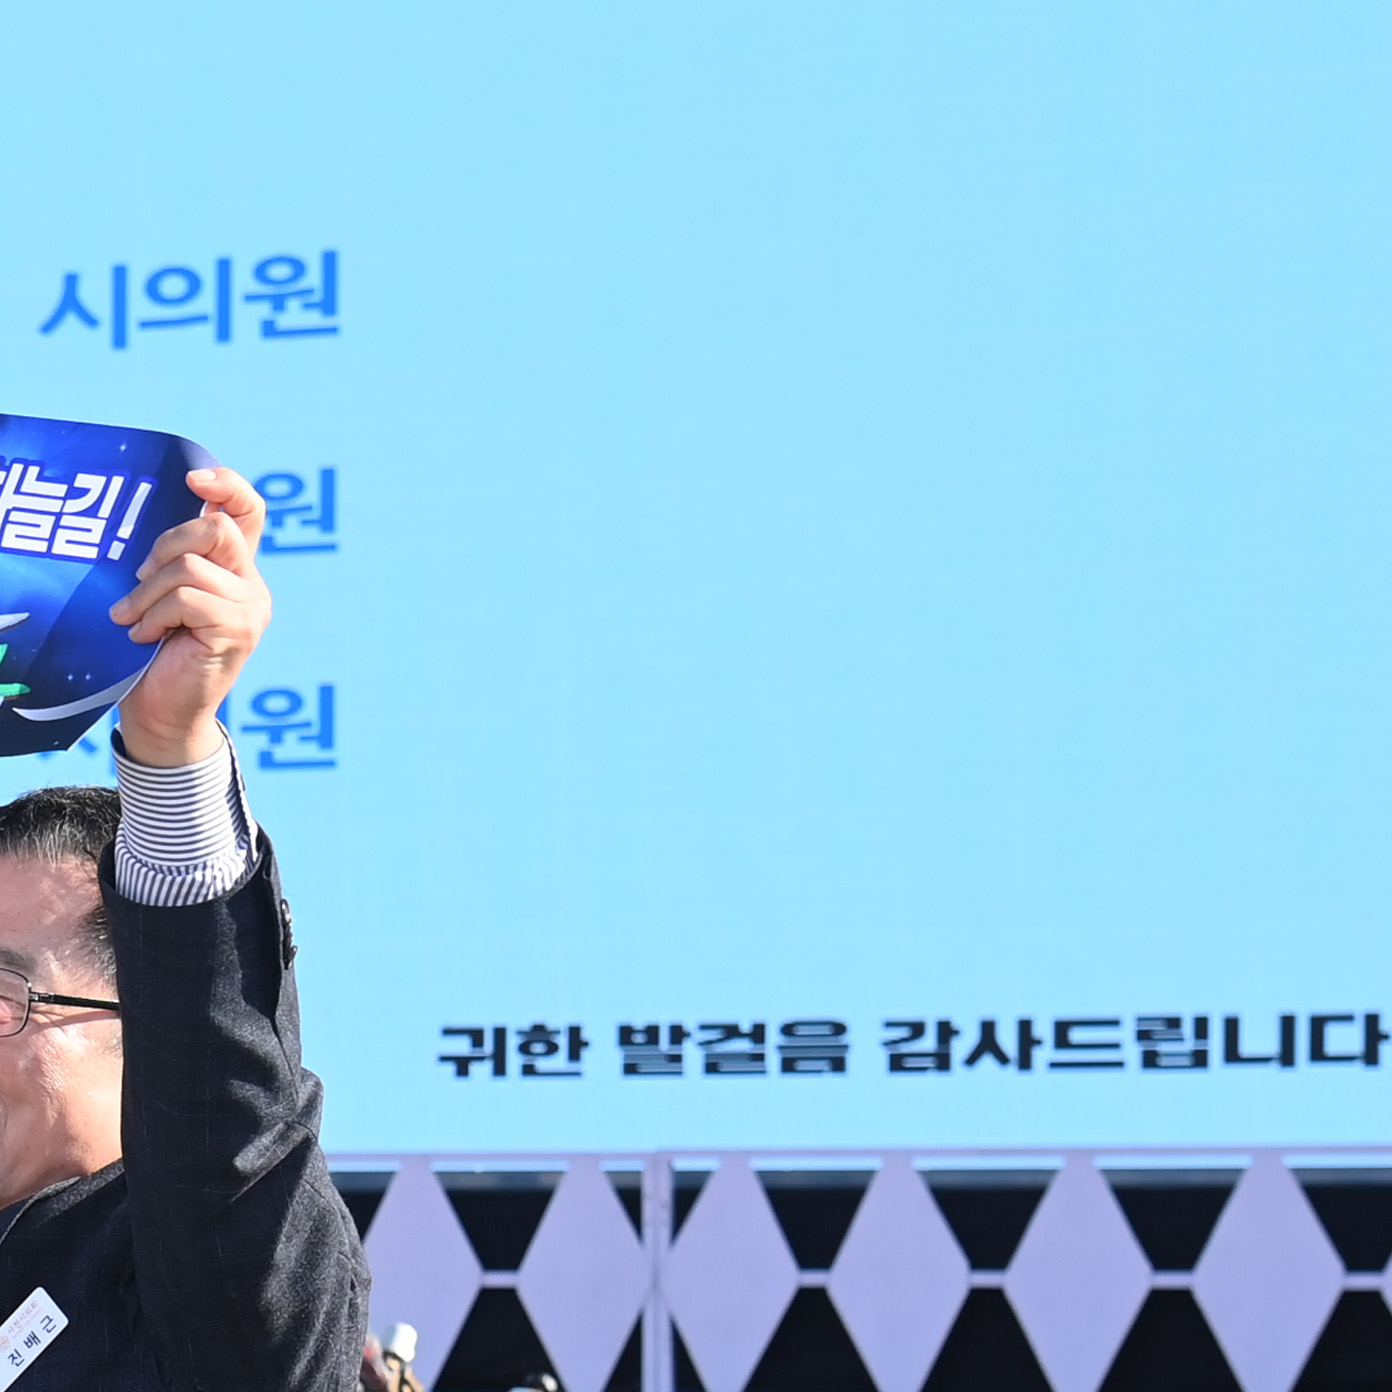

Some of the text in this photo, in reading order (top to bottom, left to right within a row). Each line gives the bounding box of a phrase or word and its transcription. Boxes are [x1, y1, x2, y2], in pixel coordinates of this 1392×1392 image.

[39, 249, 342, 349] 시의원
[438, 1012, 1392, 1079] 귀한 발걸음 감사드립니다
